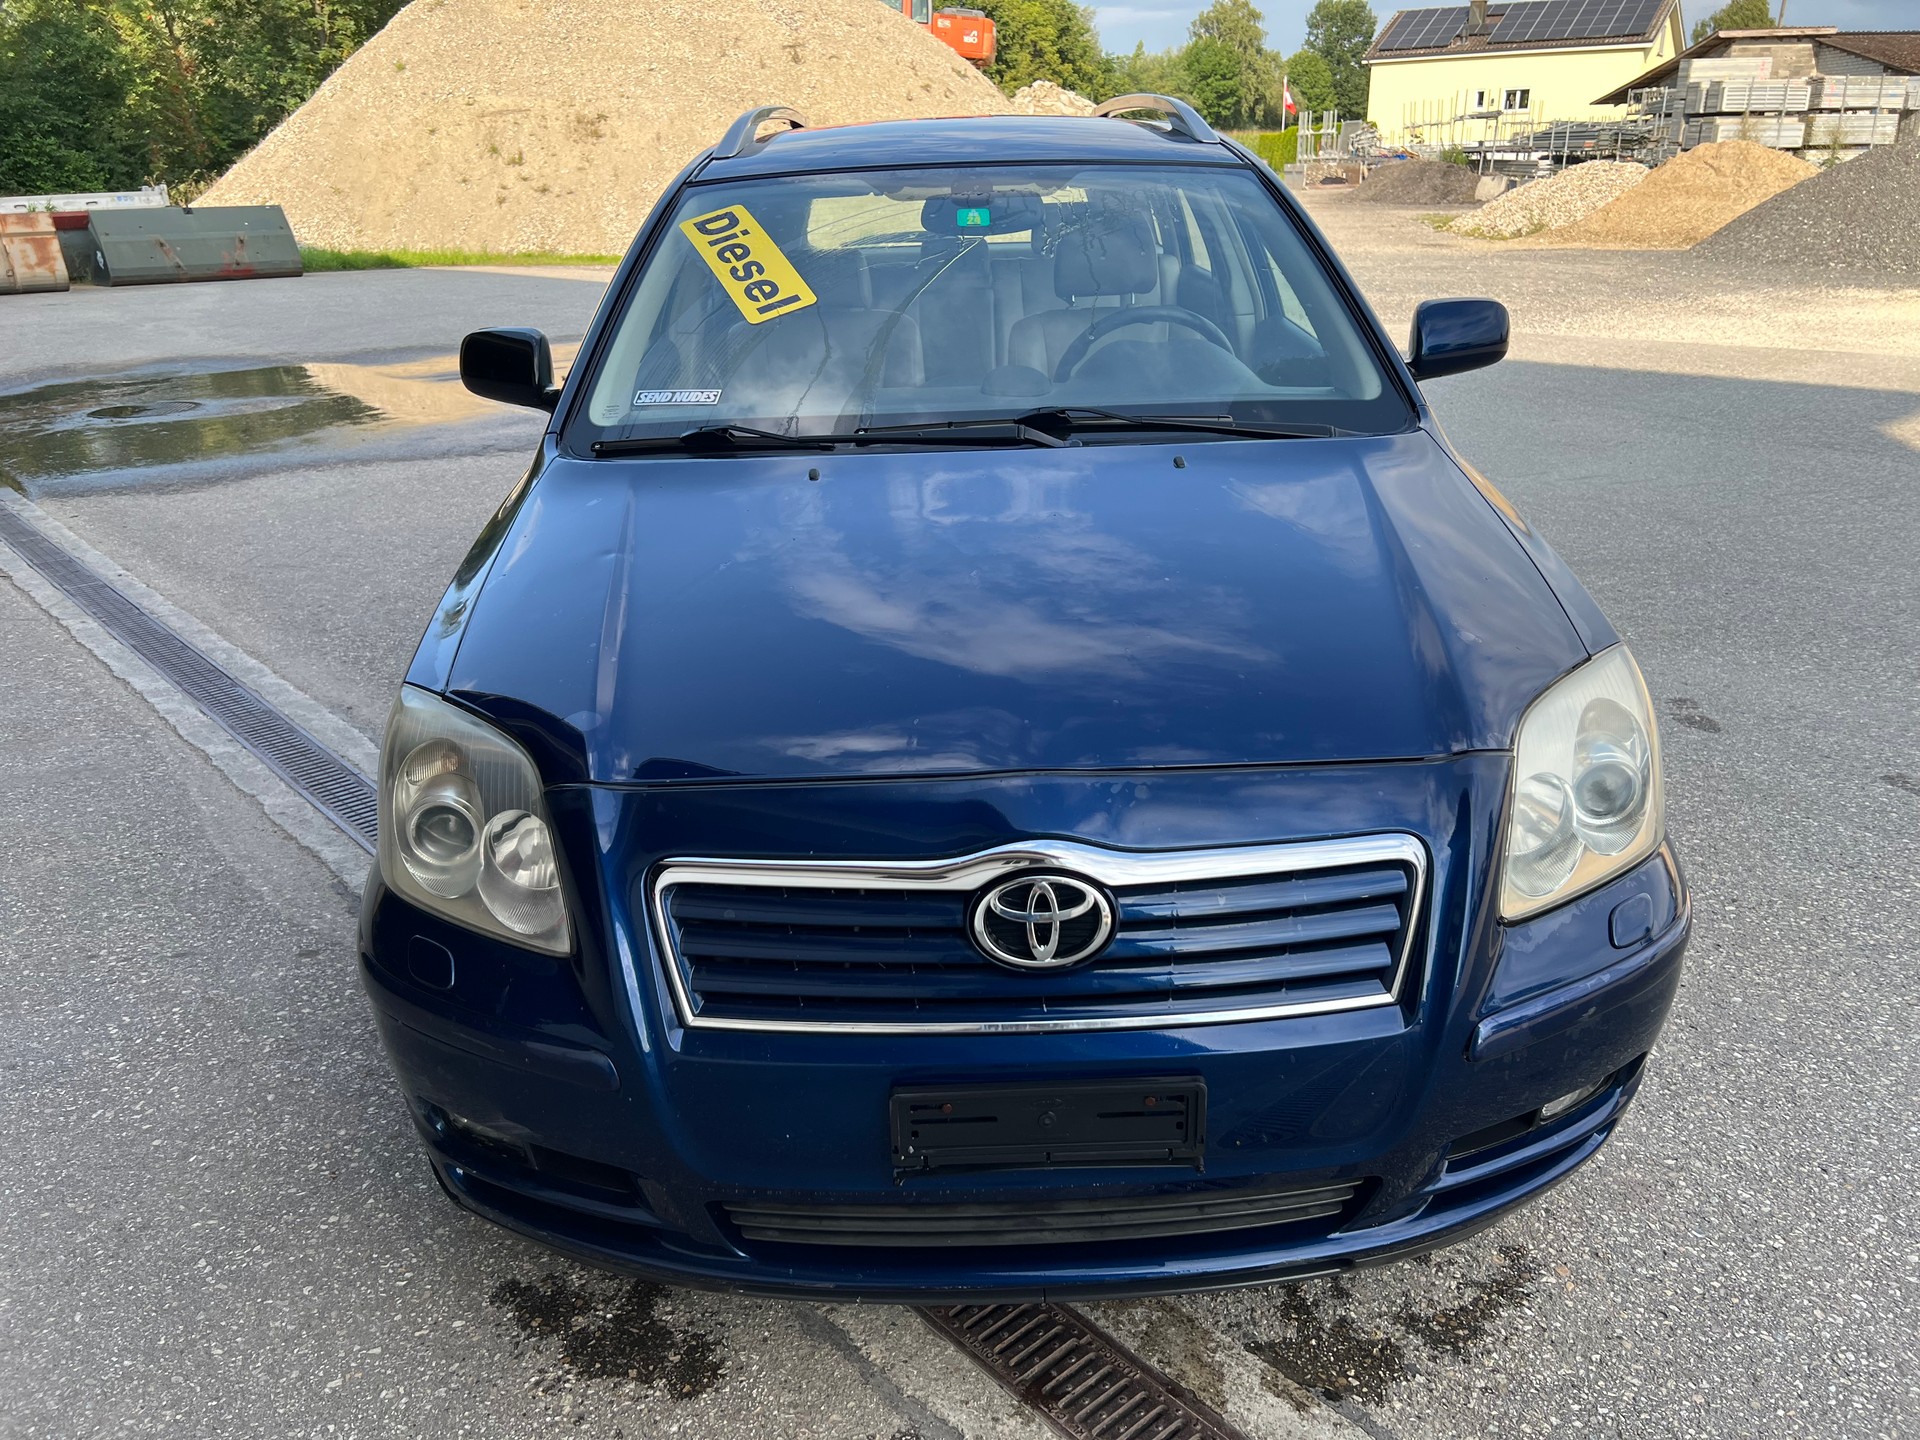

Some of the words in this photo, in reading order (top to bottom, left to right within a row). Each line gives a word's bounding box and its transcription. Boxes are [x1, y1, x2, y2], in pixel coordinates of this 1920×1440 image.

[693, 211, 802, 315] Diesel
[636, 392, 672, 403] SEND
[671, 391, 718, 402] NUDES
